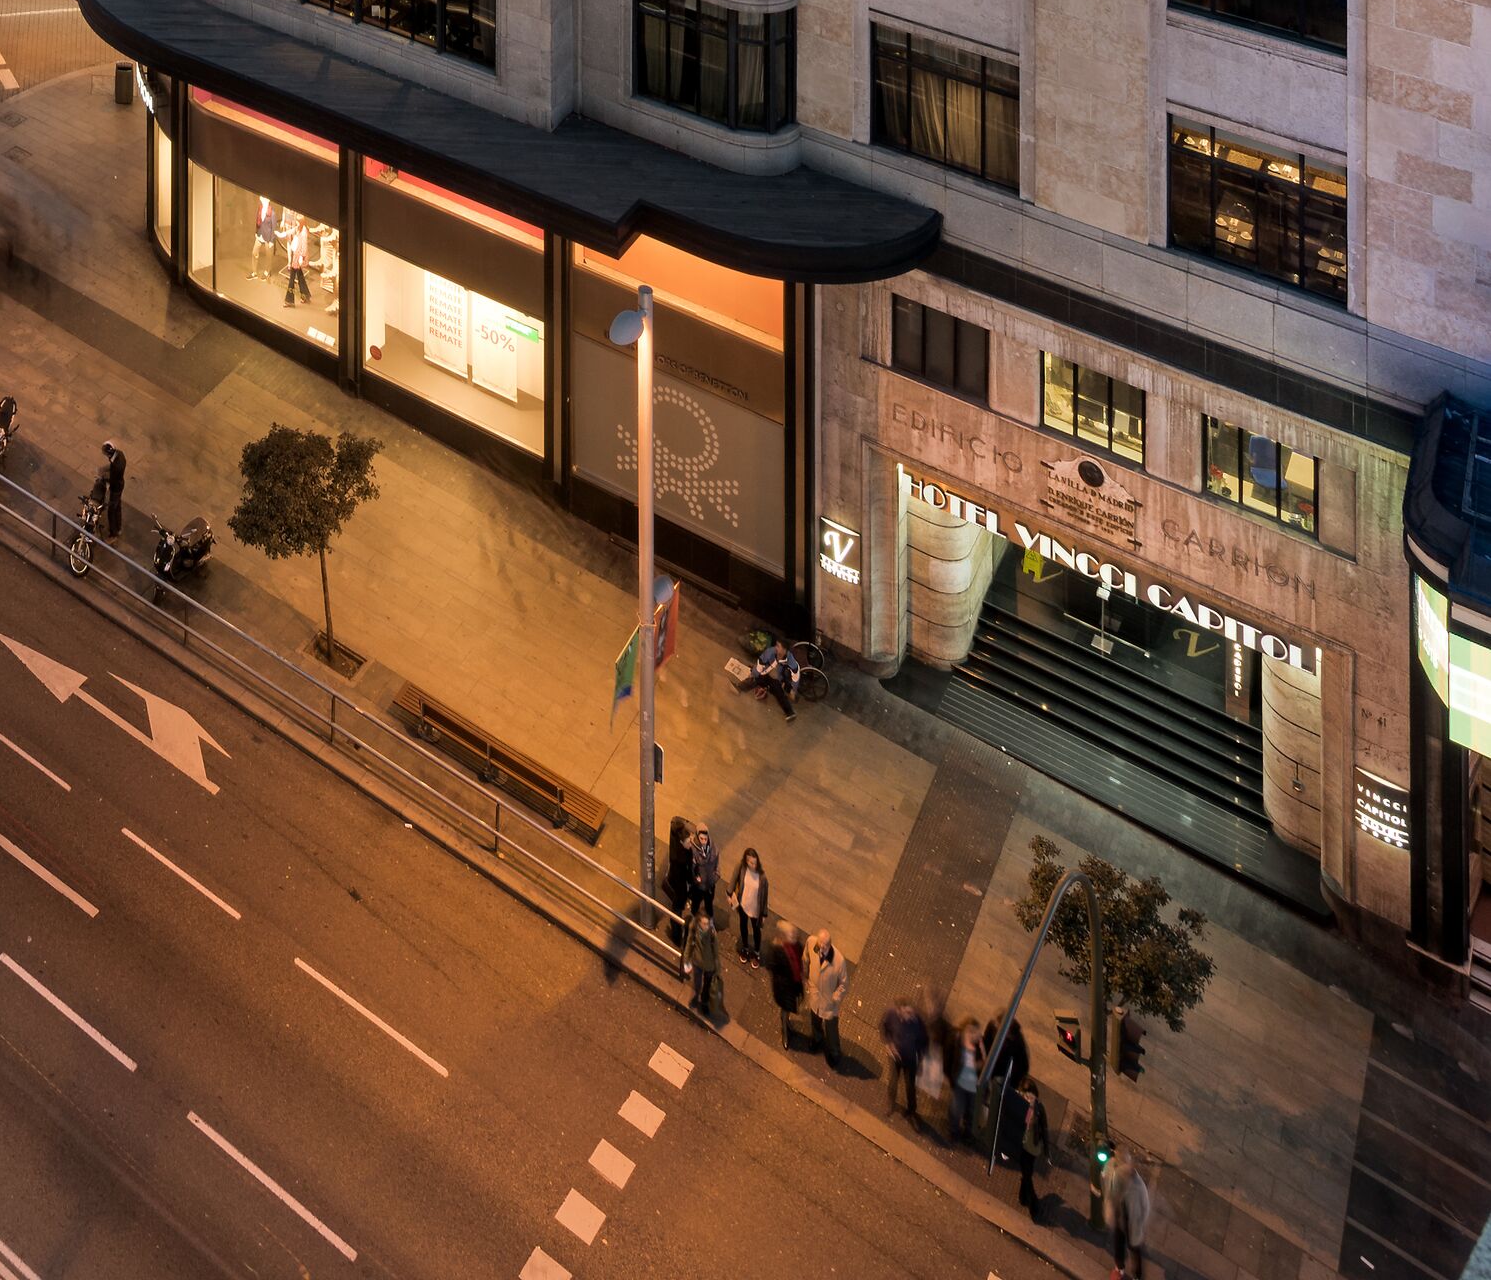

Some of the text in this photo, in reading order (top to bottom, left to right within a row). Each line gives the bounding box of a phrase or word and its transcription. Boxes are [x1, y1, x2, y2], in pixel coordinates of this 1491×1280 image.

[429, 305, 463, 327] REMATE
[429, 316, 463, 338] REMATE
[429, 326, 463, 349] REMATE
[475, 324, 515, 353] -50%
[892, 402, 1023, 473] EDIFICIO
[1098, 492, 1134, 512] MADRID
[902, 472, 1317, 677] HOTEL VINCCI CAPITOL
[1357, 783, 1408, 813] VINCCI
[1357, 798, 1408, 828] CAPITOL
